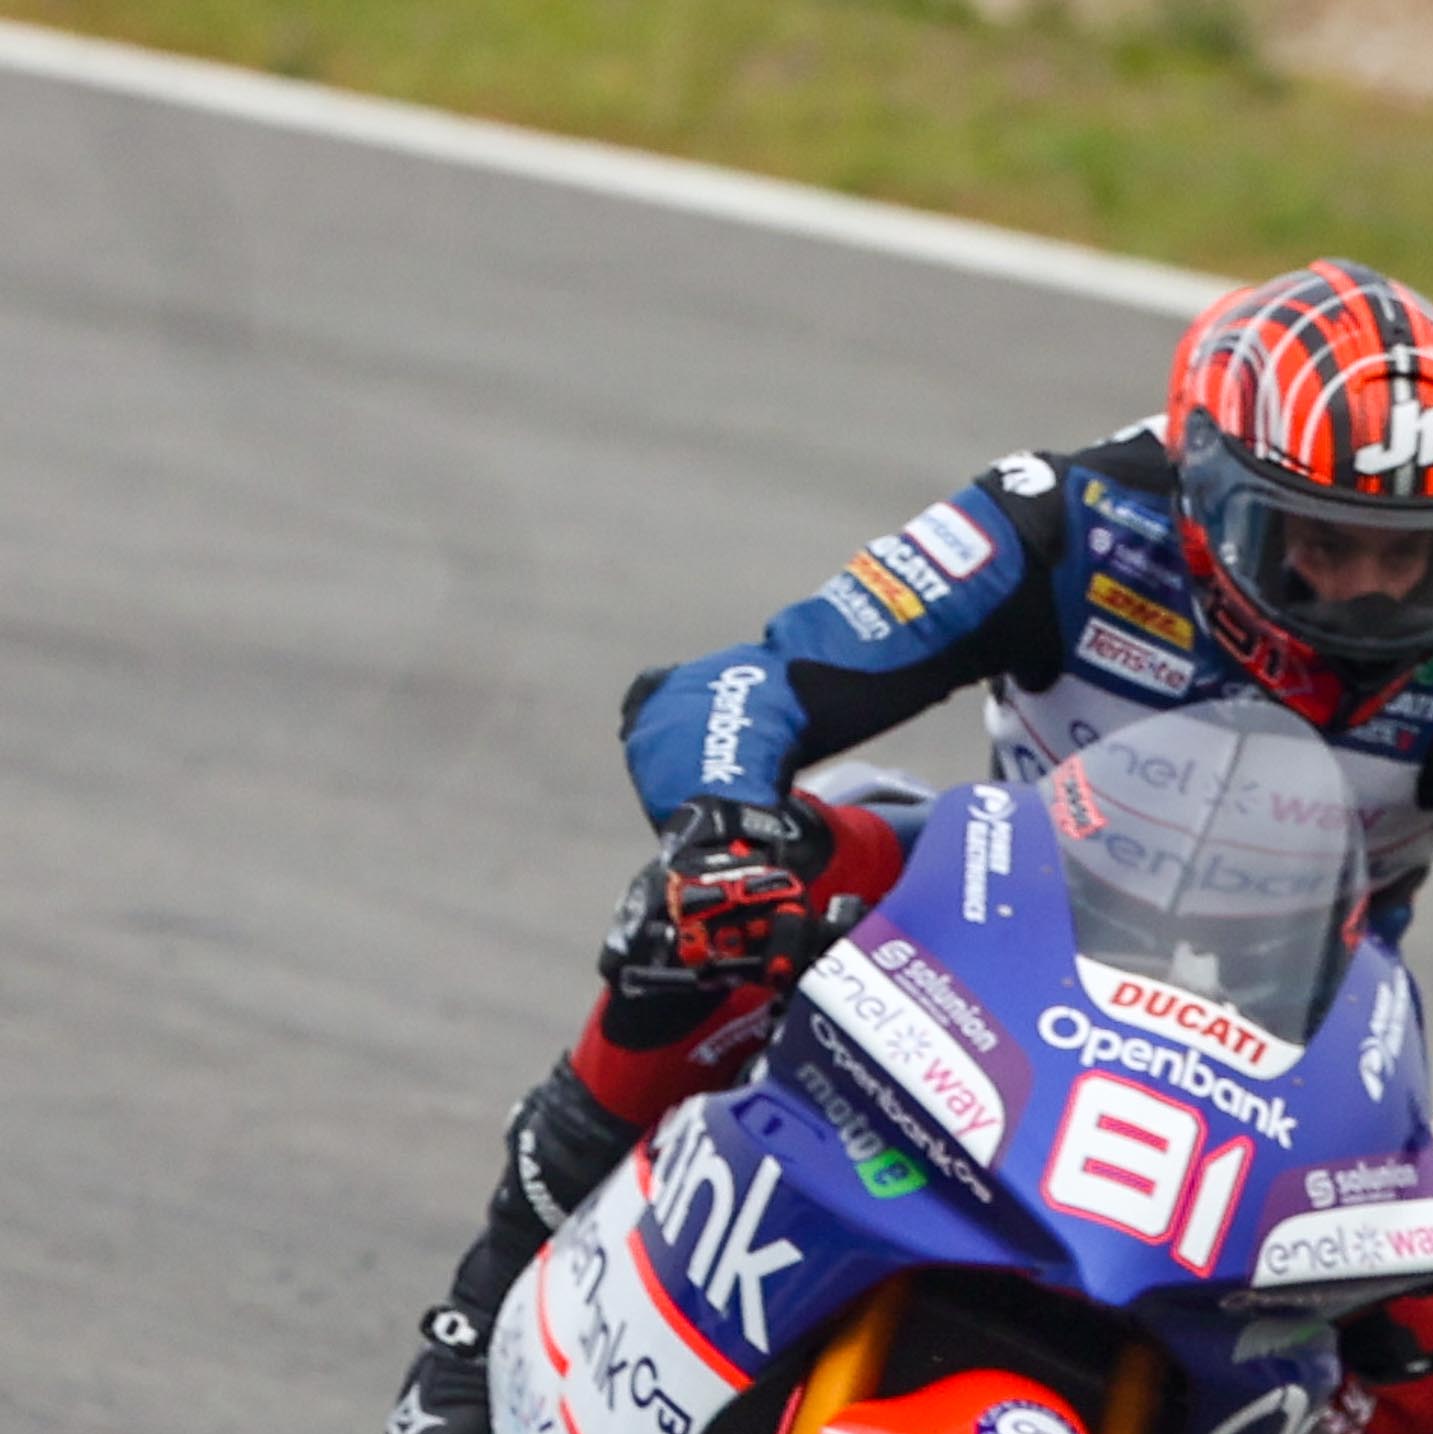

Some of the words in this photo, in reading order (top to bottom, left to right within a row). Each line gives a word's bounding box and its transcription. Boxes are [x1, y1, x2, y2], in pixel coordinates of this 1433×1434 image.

[1036, 1004, 1300, 1151] Openbank
[1110, 981, 1269, 1067] DUCATI
[922, 1057, 998, 1139] way
[1040, 1068, 1257, 1280] 81
